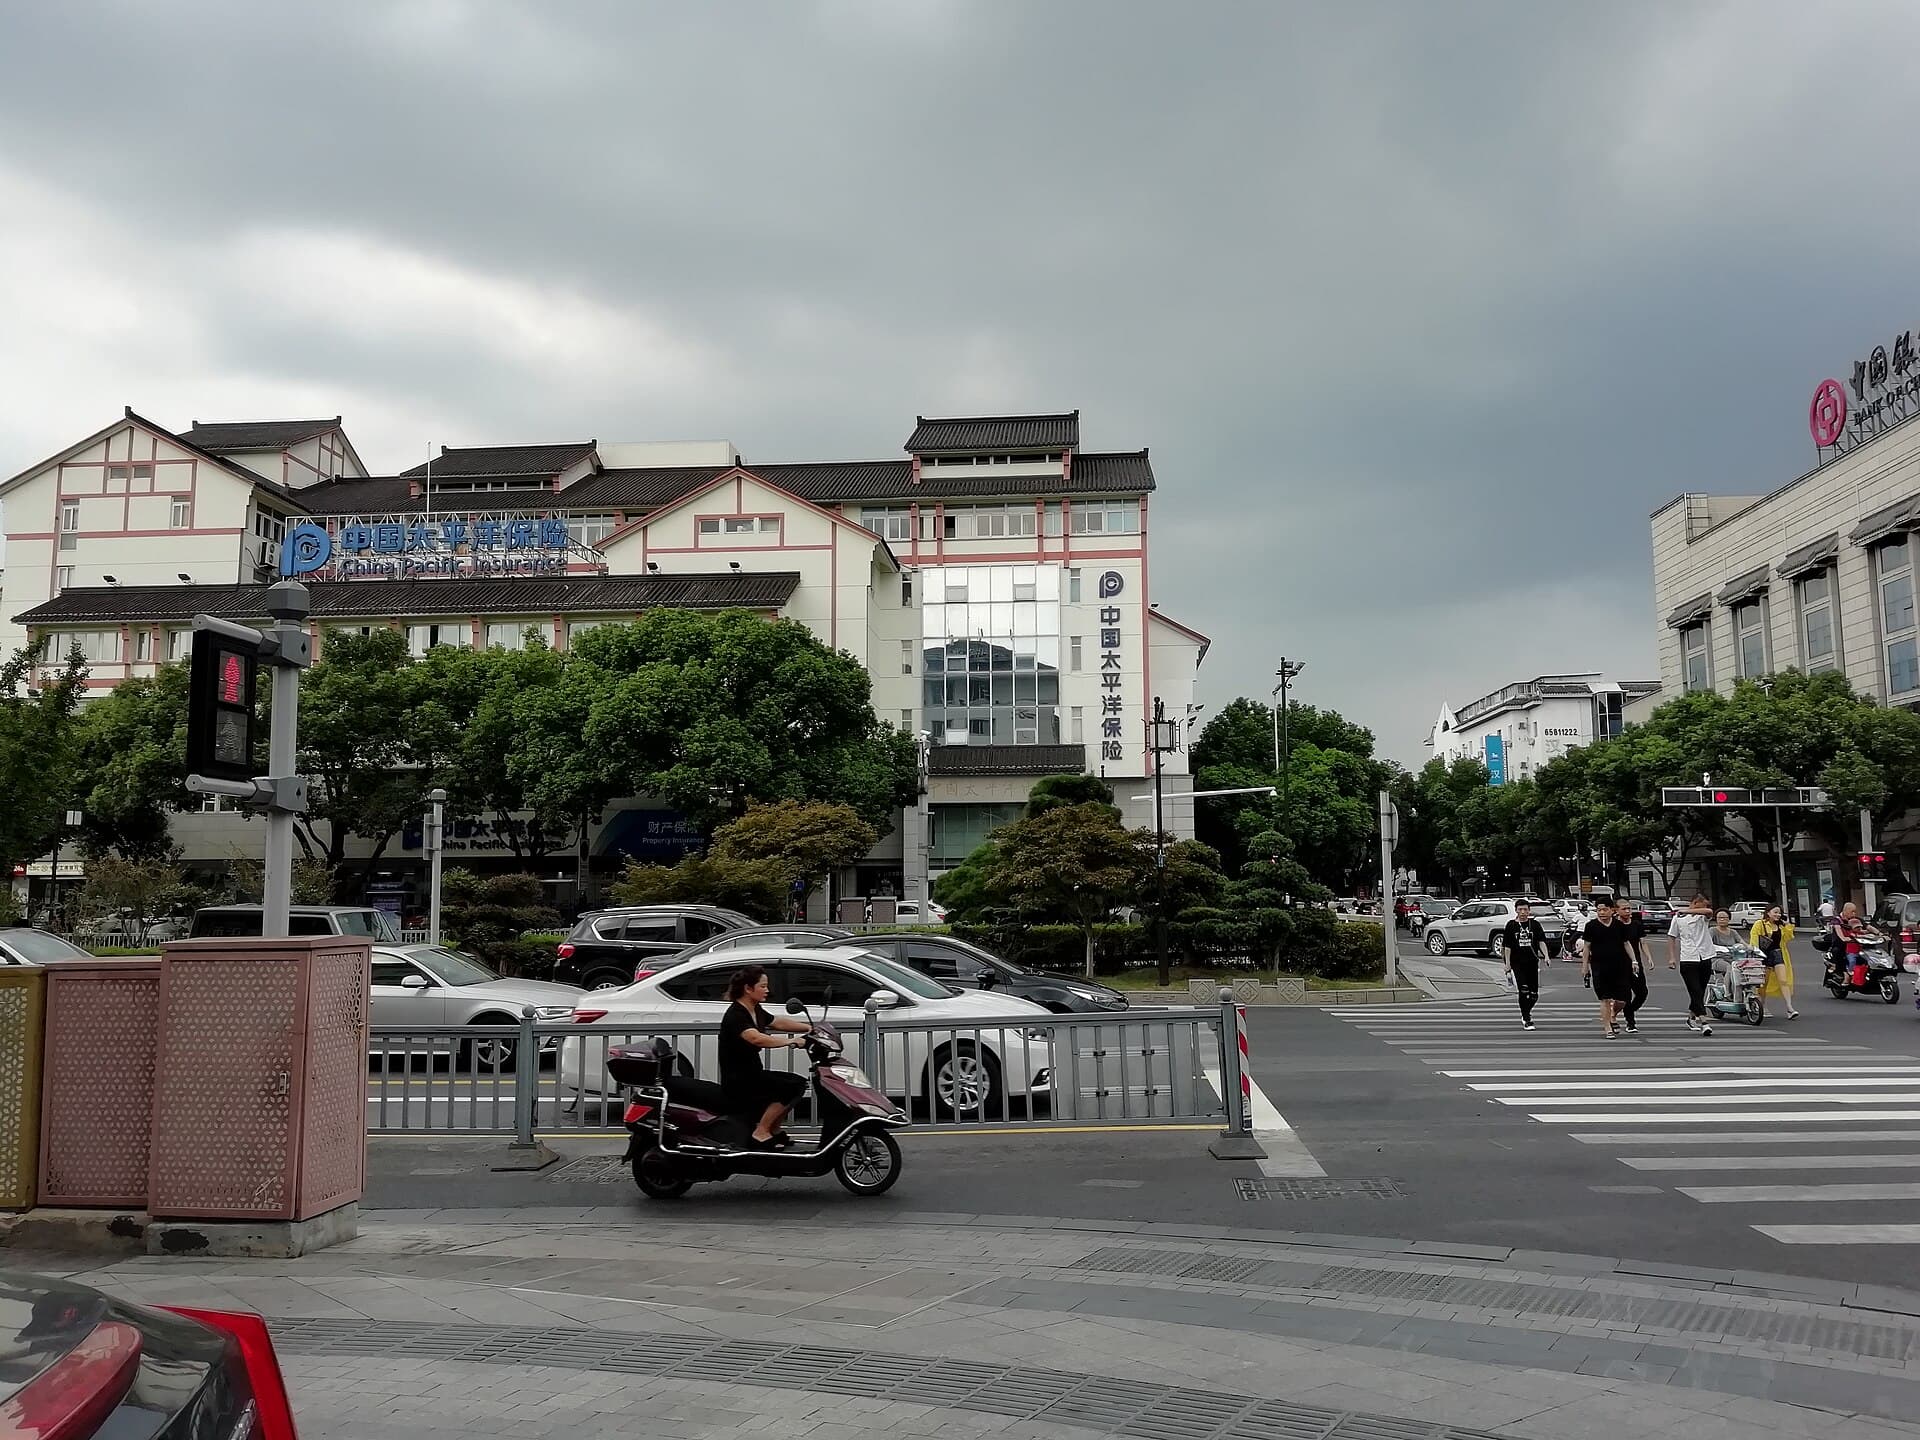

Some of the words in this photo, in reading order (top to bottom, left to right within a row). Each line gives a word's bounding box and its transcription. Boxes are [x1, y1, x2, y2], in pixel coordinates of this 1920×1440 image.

[341, 518, 568, 552] 中国太平洋保险
[341, 558, 394, 575] China
[403, 557, 465, 574] Pacific
[473, 556, 567, 572] Insurance
[1100, 605, 1122, 761] 中国太平洋保险
[442, 839, 466, 849] hina
